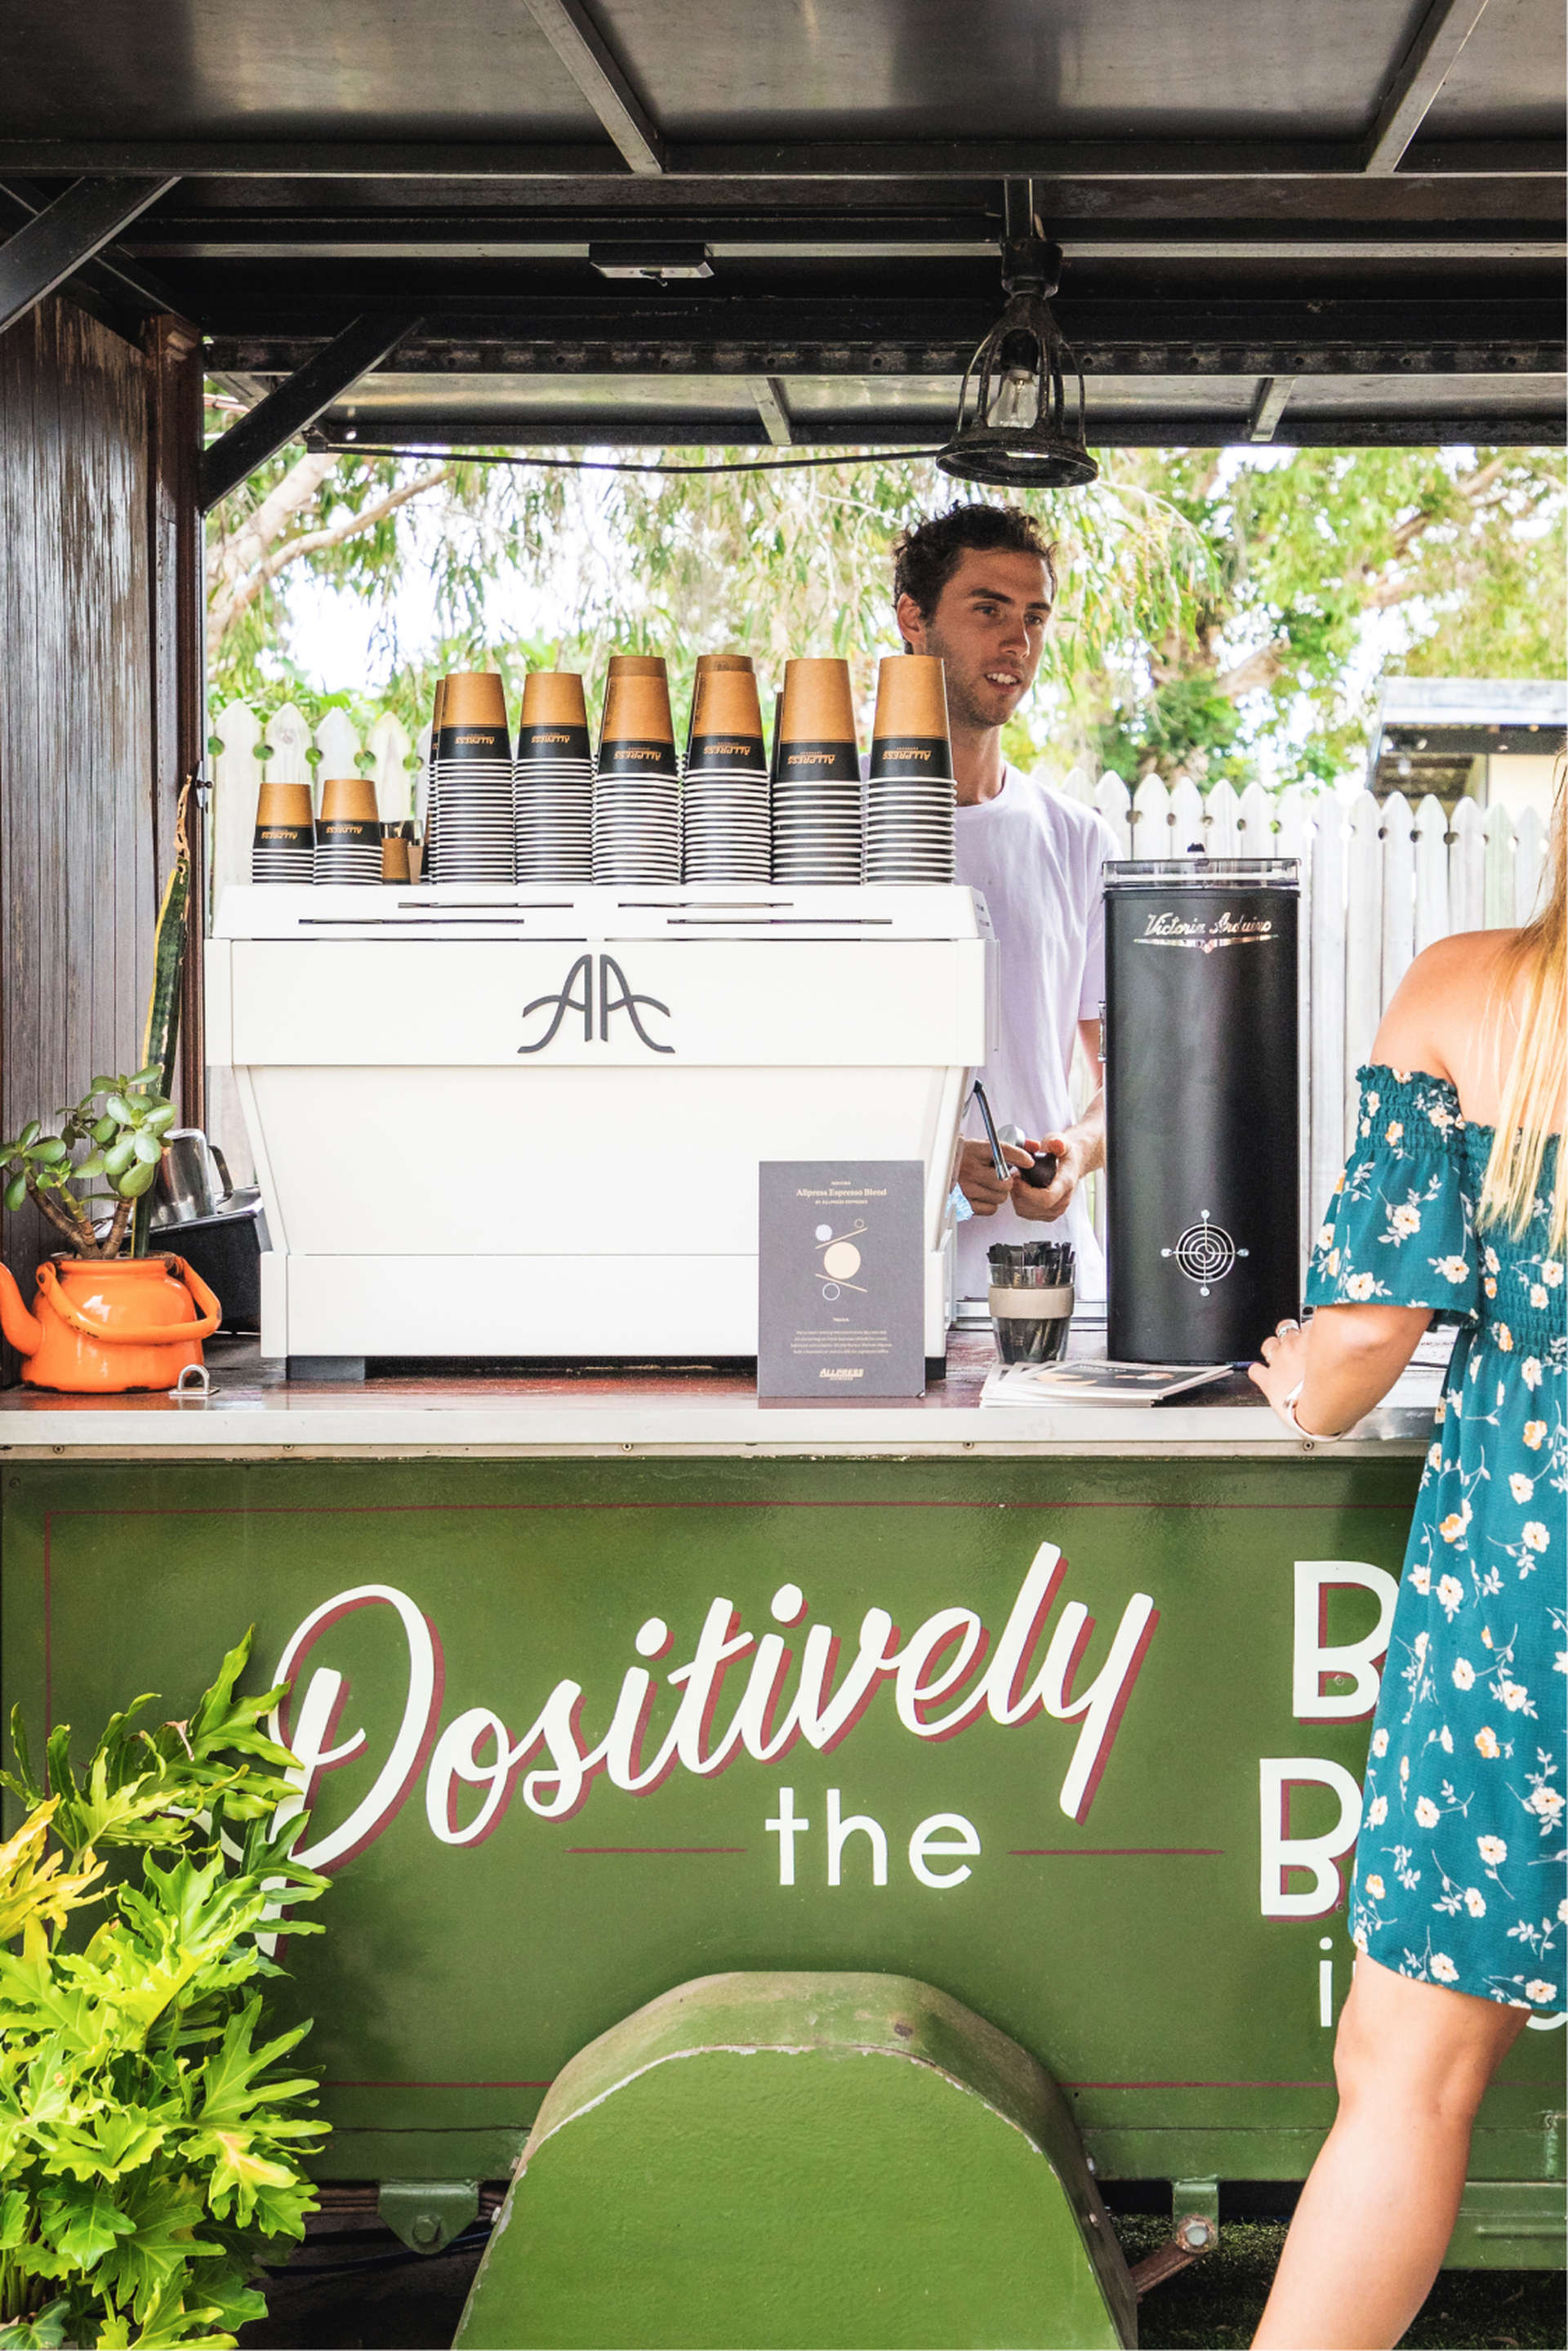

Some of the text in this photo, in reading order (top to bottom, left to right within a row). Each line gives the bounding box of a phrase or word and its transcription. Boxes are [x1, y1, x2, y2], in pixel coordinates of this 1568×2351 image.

[613, 751, 661, 761] ALLPRESS
[704, 746, 751, 756] ALLPRESS
[883, 750, 932, 761] ALLPRESS
[788, 755, 836, 765] ALLPRESS
[796, 1188, 887, 1198] Allpress Espresso Blend
[819, 1368, 864, 1378] ALLPRESS
[167, 1541, 1160, 1957] Positively
[764, 1787, 981, 1889] the
